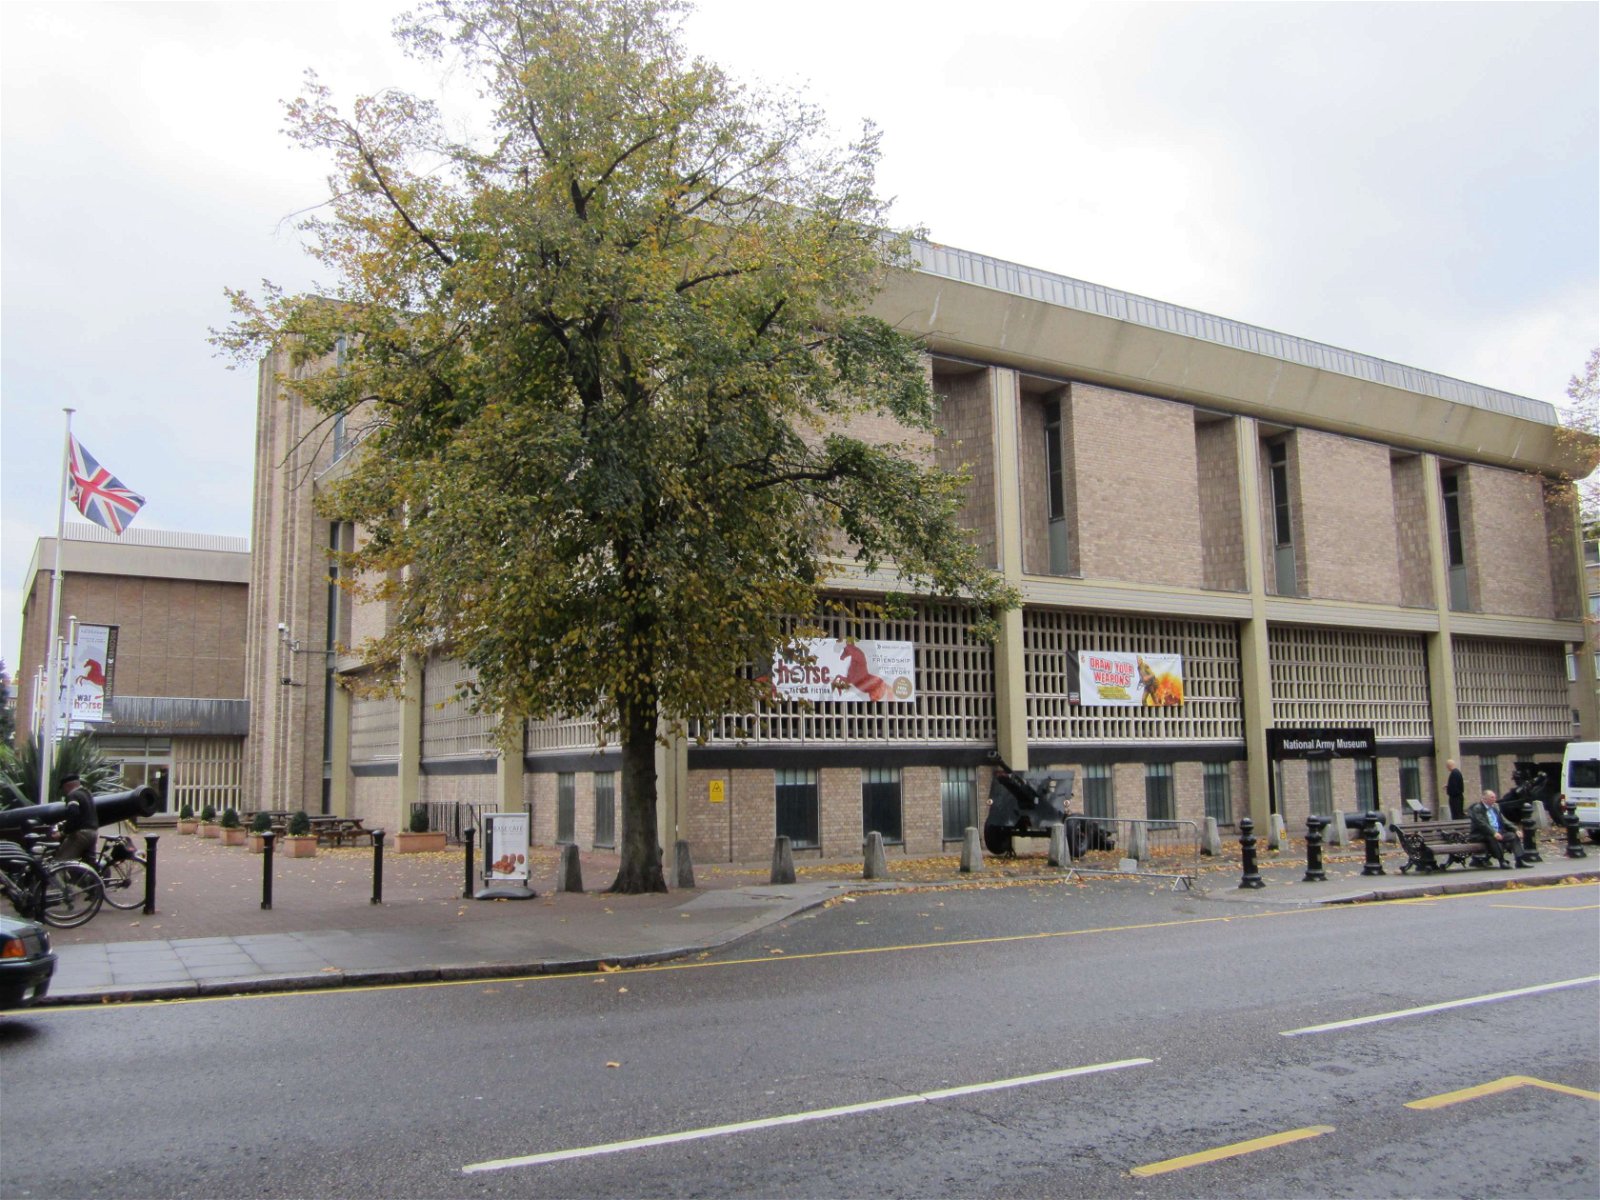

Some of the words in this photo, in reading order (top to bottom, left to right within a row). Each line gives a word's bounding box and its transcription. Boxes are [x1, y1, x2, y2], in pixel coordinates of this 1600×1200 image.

[776, 659, 831, 684] horse
[1089, 656, 1112, 673] DRAW
[1114, 661, 1136, 677] YOUR
[1093, 671, 1132, 688] WEAPONS
[74, 698, 102, 710] horse
[1283, 739, 1315, 750] National
[1316, 739, 1335, 751] Army
[1337, 738, 1367, 749] Museum
